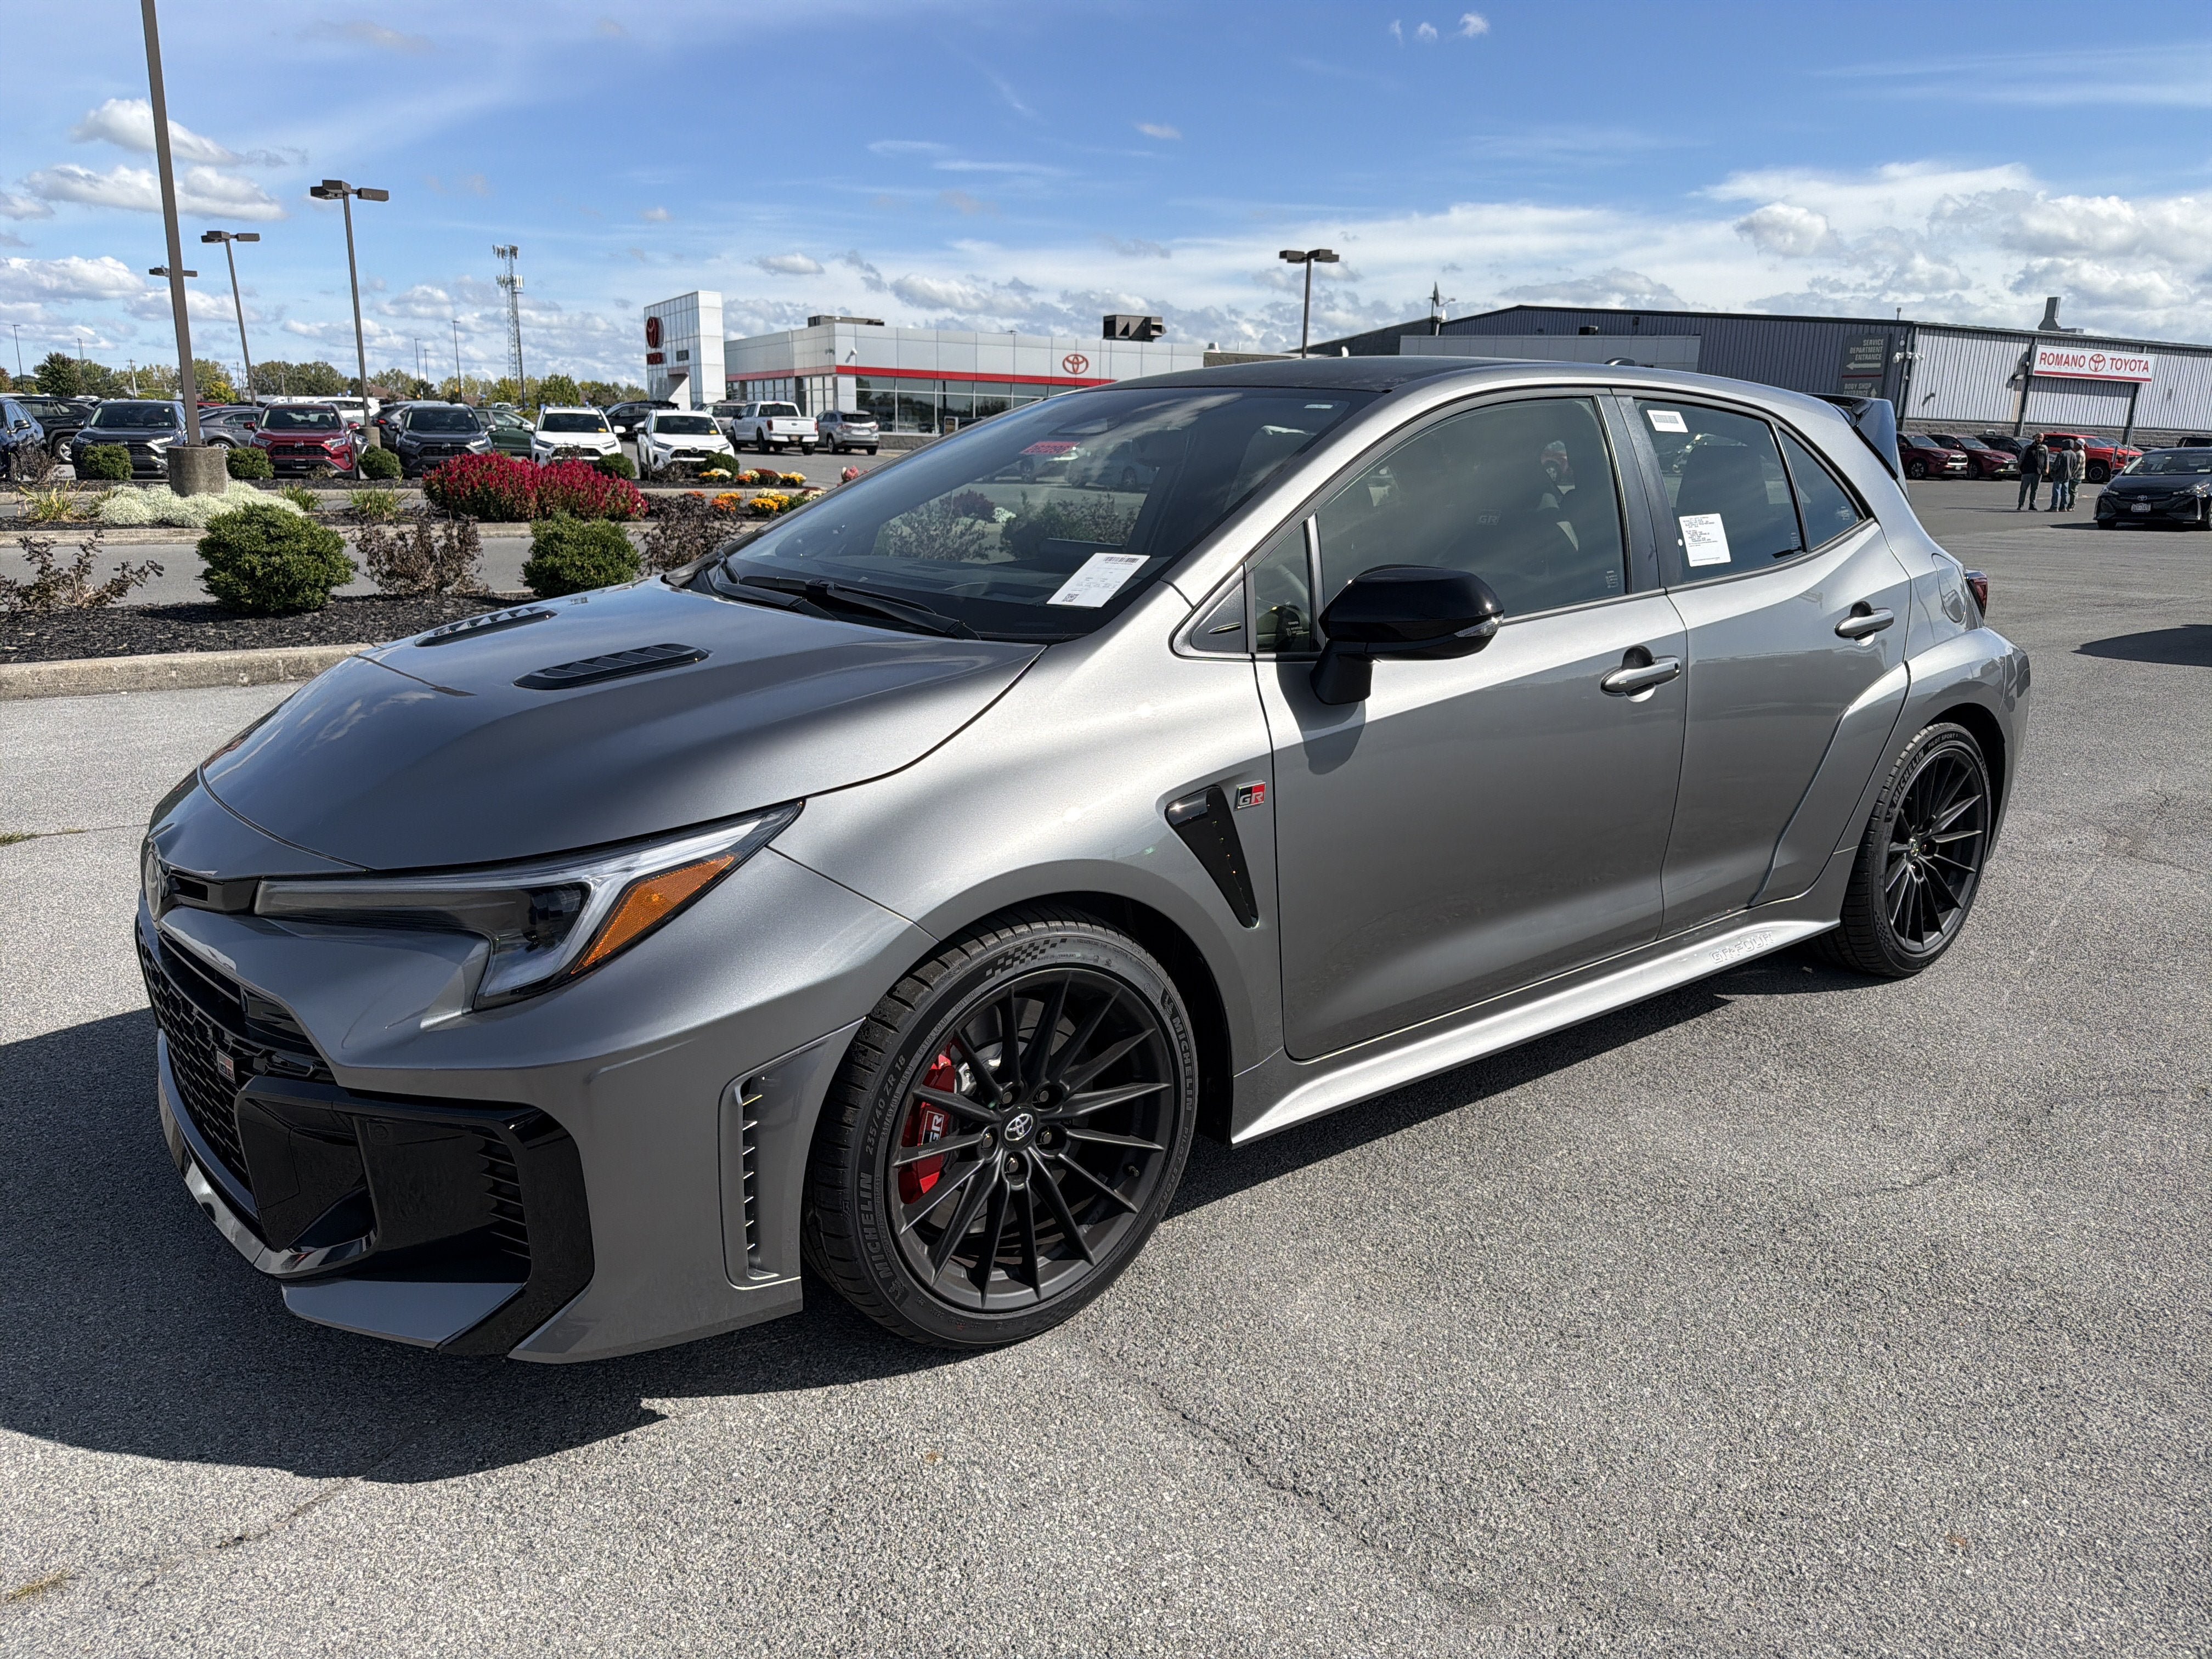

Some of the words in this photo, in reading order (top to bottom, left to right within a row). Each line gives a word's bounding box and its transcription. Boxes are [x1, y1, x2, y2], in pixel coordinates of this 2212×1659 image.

[2039, 352, 2085, 368] ROMANO
[2109, 358, 2149, 373] TOYOTA
[1928, 737, 1942, 749] PILOT
[1893, 748, 1924, 805] MICHELIN
[1239, 793, 1264, 806] GR
[955, 990, 978, 1011] OUTSIDE
[918, 1033, 935, 1055] EXTRA
[933, 1018, 947, 1036] LOAD
[1172, 1016, 1192, 1111] MICHELIN
[866, 1098, 885, 1155] 235/40
[883, 1074, 896, 1096] ZR
[895, 1054, 906, 1071] 18
[1177, 1126, 1189, 1164] PILOT
[1159, 1167, 1178, 1210] SPORT
[860, 1172, 894, 1279] MICHELIN
